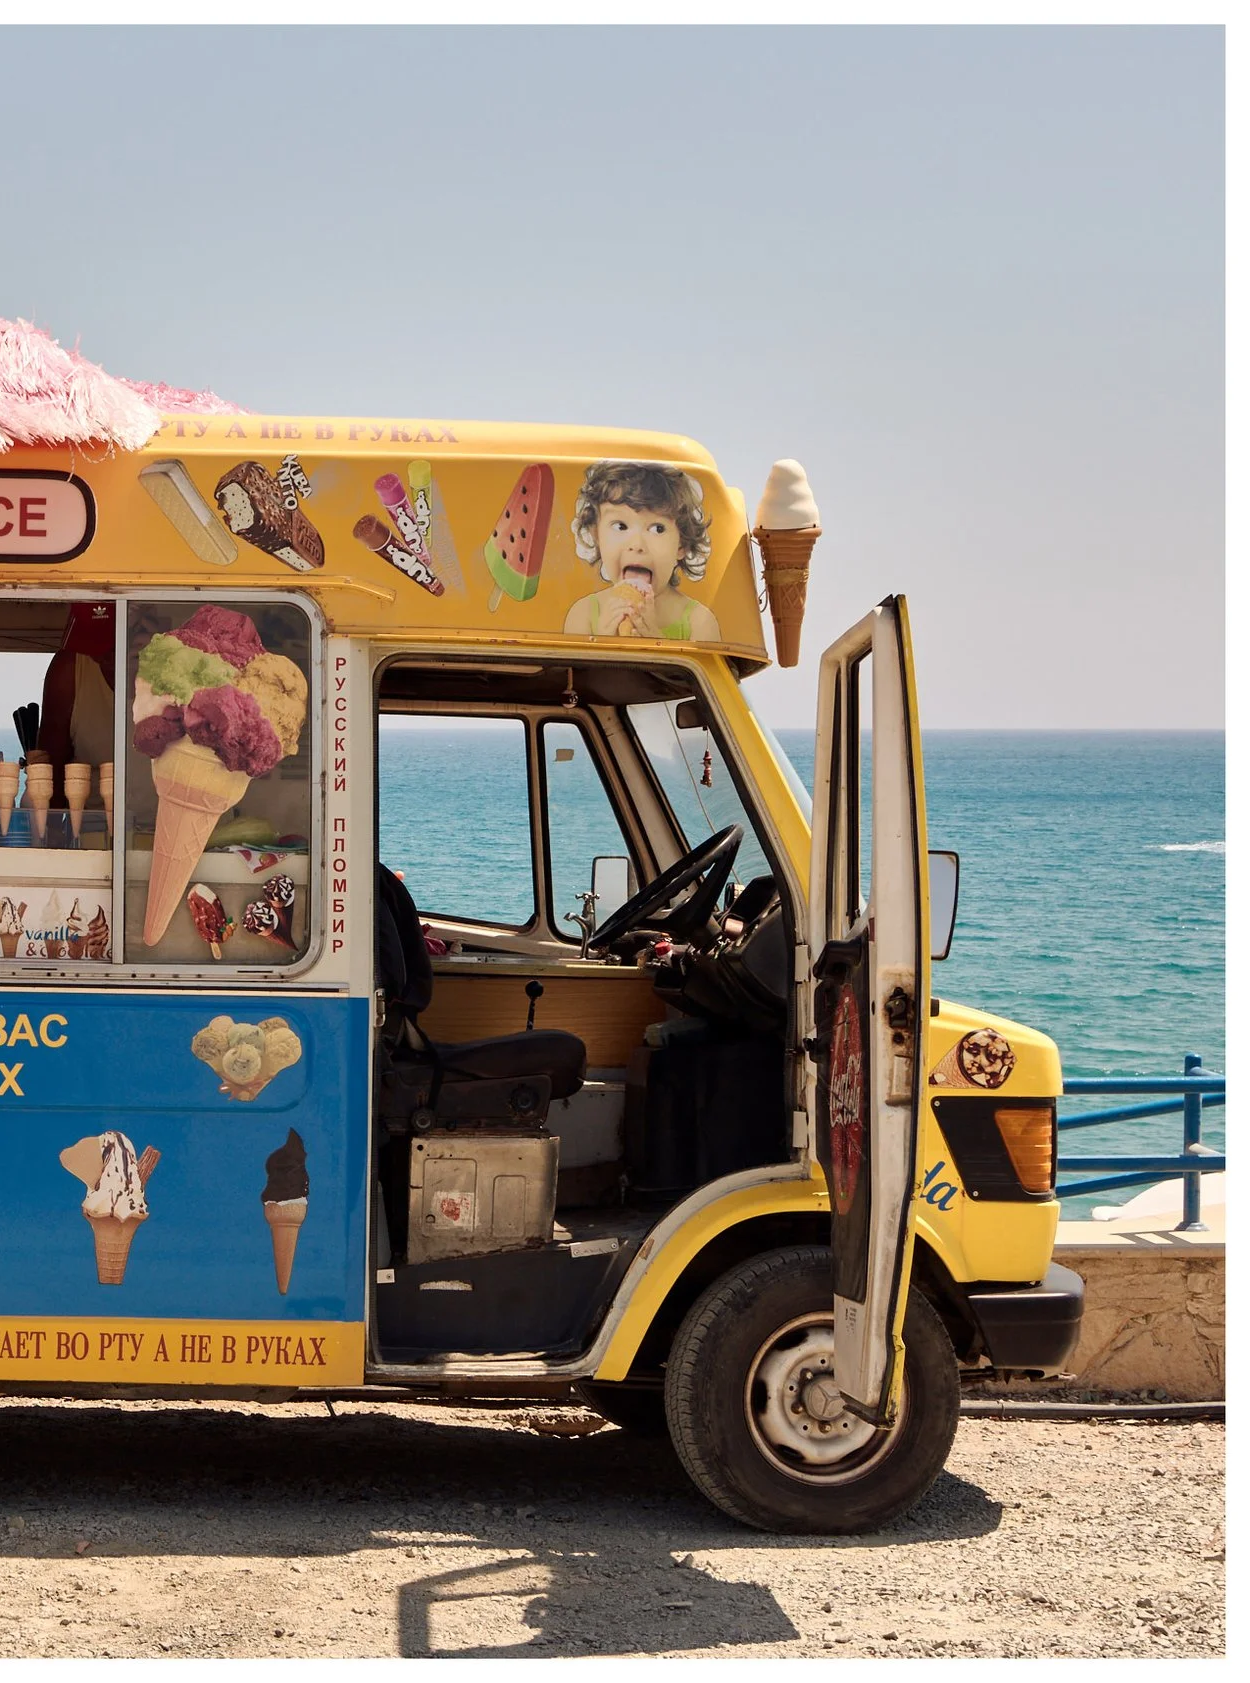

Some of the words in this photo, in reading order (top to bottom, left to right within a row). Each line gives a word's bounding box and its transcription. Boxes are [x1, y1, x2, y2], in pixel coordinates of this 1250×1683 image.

[225, 421, 247, 438] А
[260, 422, 302, 440] НЕ
[314, 423, 335, 440] В
[348, 423, 459, 443] РУКАХ
[333, 657, 347, 792] РУССКИЙ
[331, 817, 348, 954] ПЛОМБИР
[55, 1331, 90, 1361] ВО
[99, 1332, 145, 1361] РТУ
[153, 1333, 170, 1362] А
[180, 1334, 211, 1363] НЕ
[221, 1335, 237, 1364] В
[246, 1336, 327, 1365] РУКАХ
